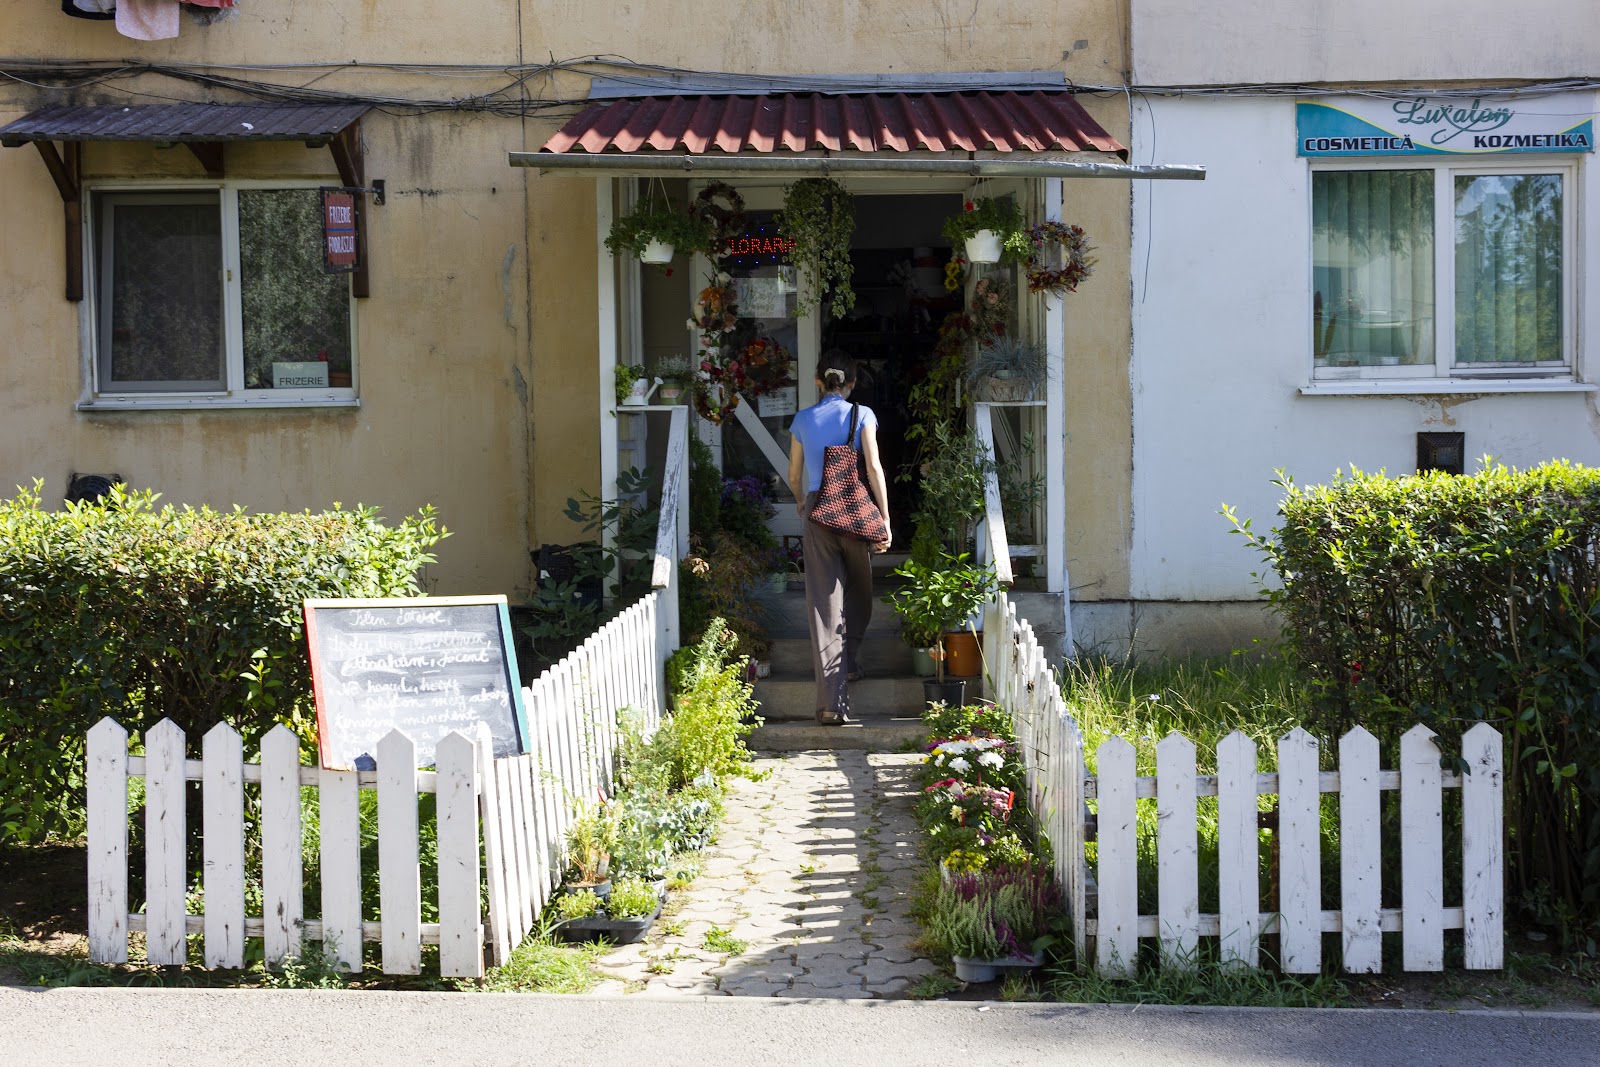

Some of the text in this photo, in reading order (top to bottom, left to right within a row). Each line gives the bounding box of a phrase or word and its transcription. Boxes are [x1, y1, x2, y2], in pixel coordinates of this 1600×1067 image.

[1305, 134, 1414, 151] COSMETICĂ
[1474, 134, 1588, 148] KOZMETIKA
[329, 206, 351, 223] FRIZERIE
[279, 377, 323, 386] FRIZERIE
